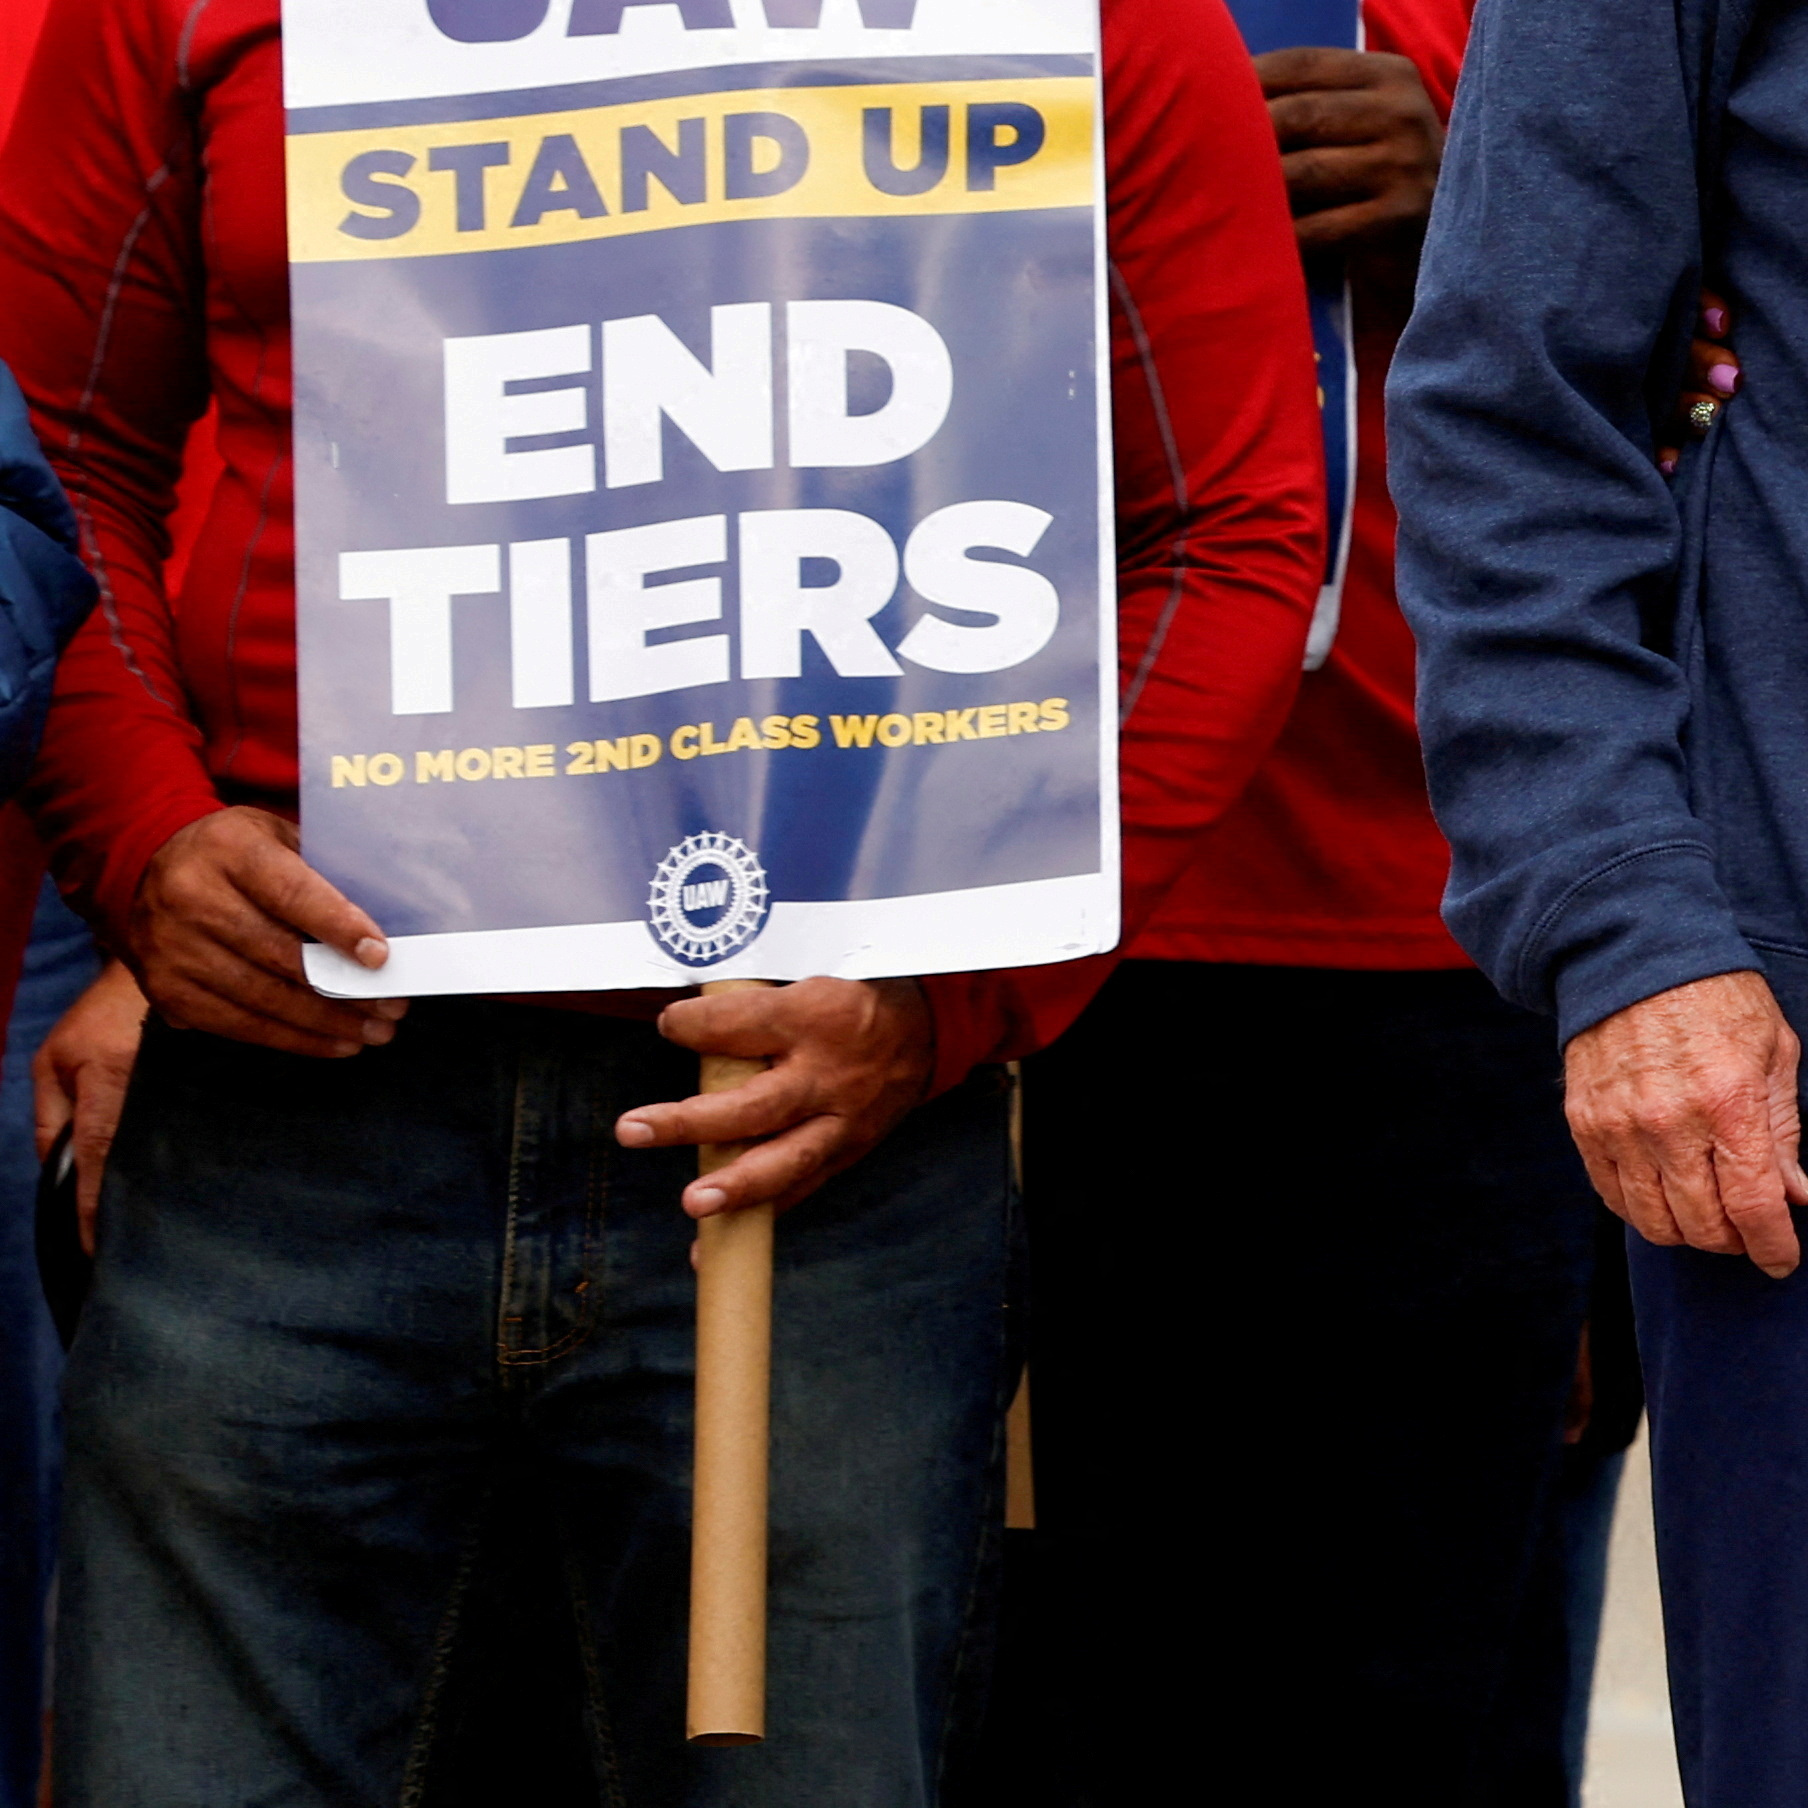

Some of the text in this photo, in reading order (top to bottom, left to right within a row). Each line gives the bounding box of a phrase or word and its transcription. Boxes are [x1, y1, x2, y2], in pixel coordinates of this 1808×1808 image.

[338, 101, 1046, 242] STAND UP
[443, 299, 954, 505] END
[338, 500, 1060, 716] TIERS
[331, 697, 1070, 788] NO MORE 2ND CLASS WORKERS
[683, 879, 730, 912] UAW
